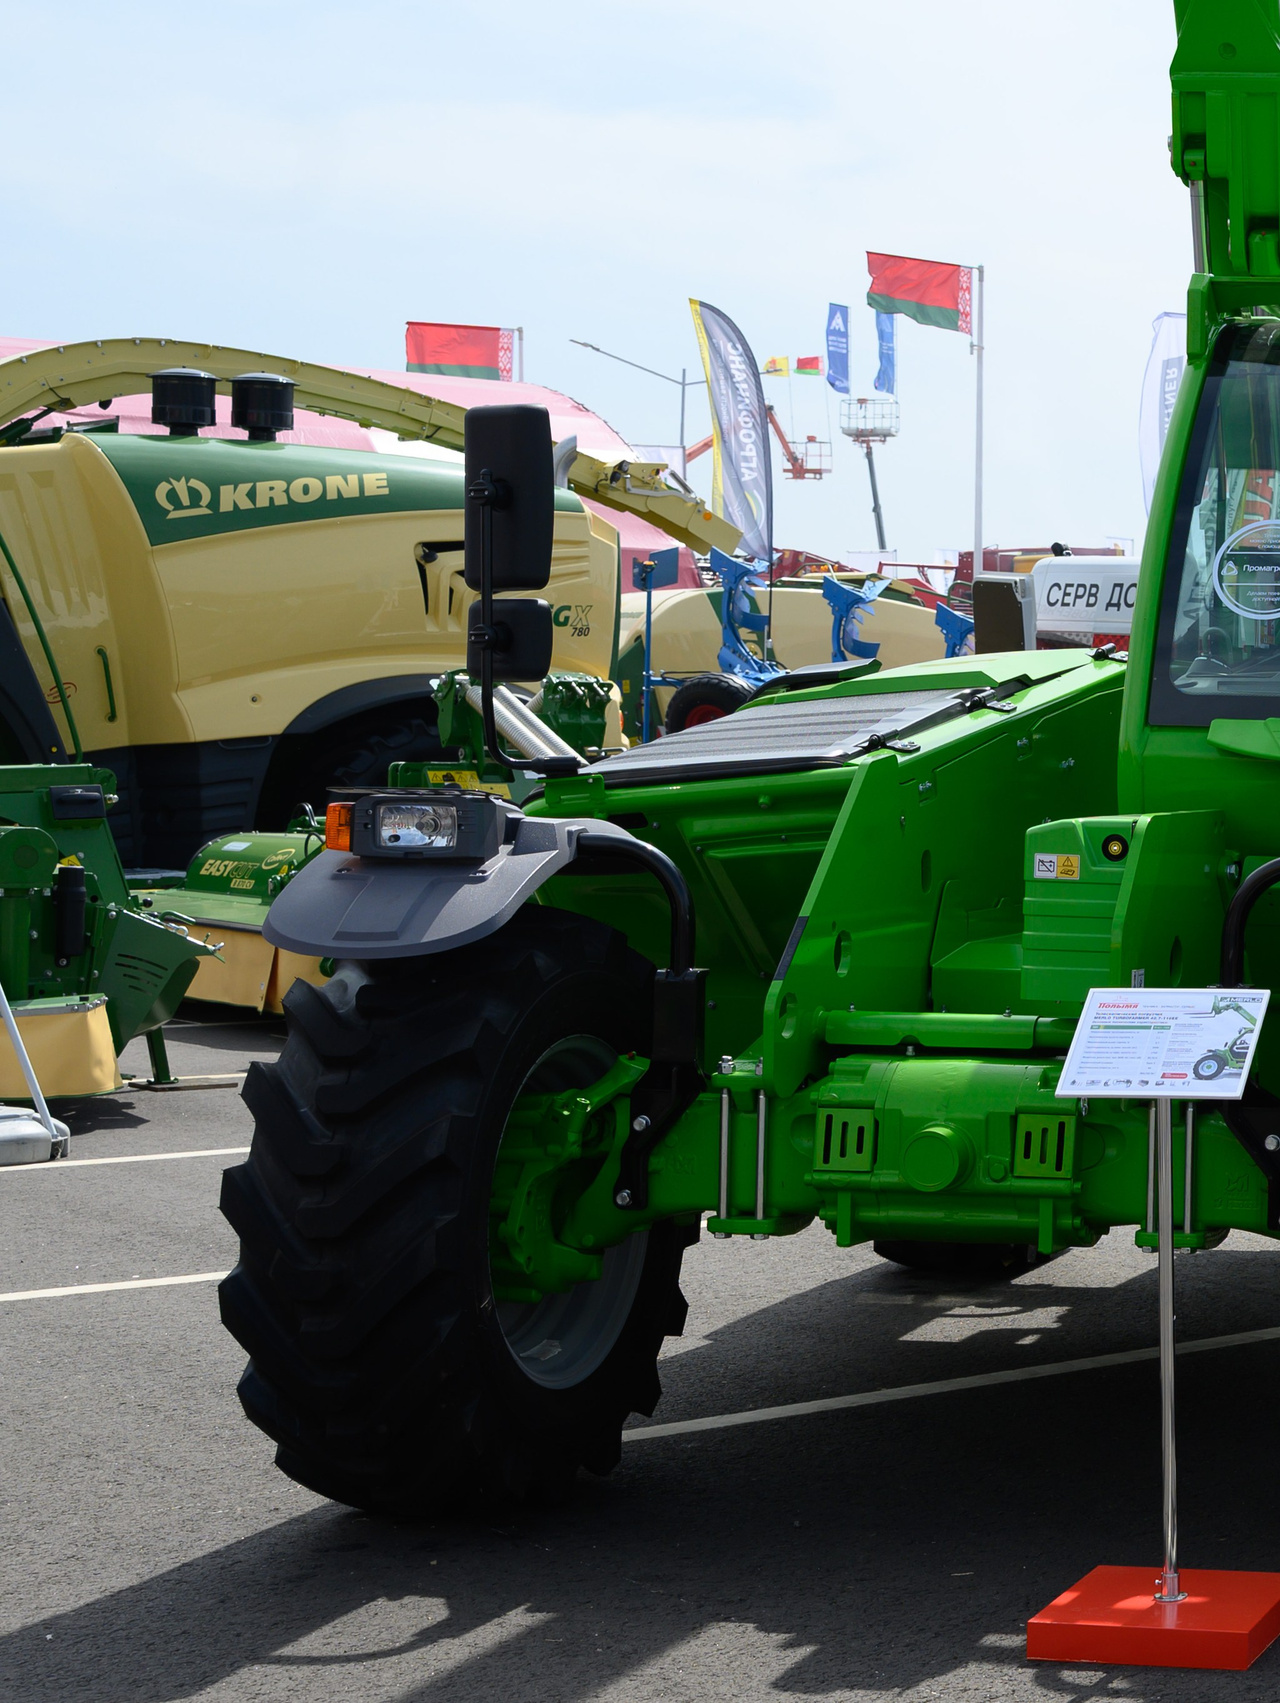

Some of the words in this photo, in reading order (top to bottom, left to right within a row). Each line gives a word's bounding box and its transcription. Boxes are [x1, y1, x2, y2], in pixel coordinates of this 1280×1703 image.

[218, 472, 390, 513] KRONE
[1046, 582, 1100, 608] СЕРВ
[570, 626, 591, 638] 780
